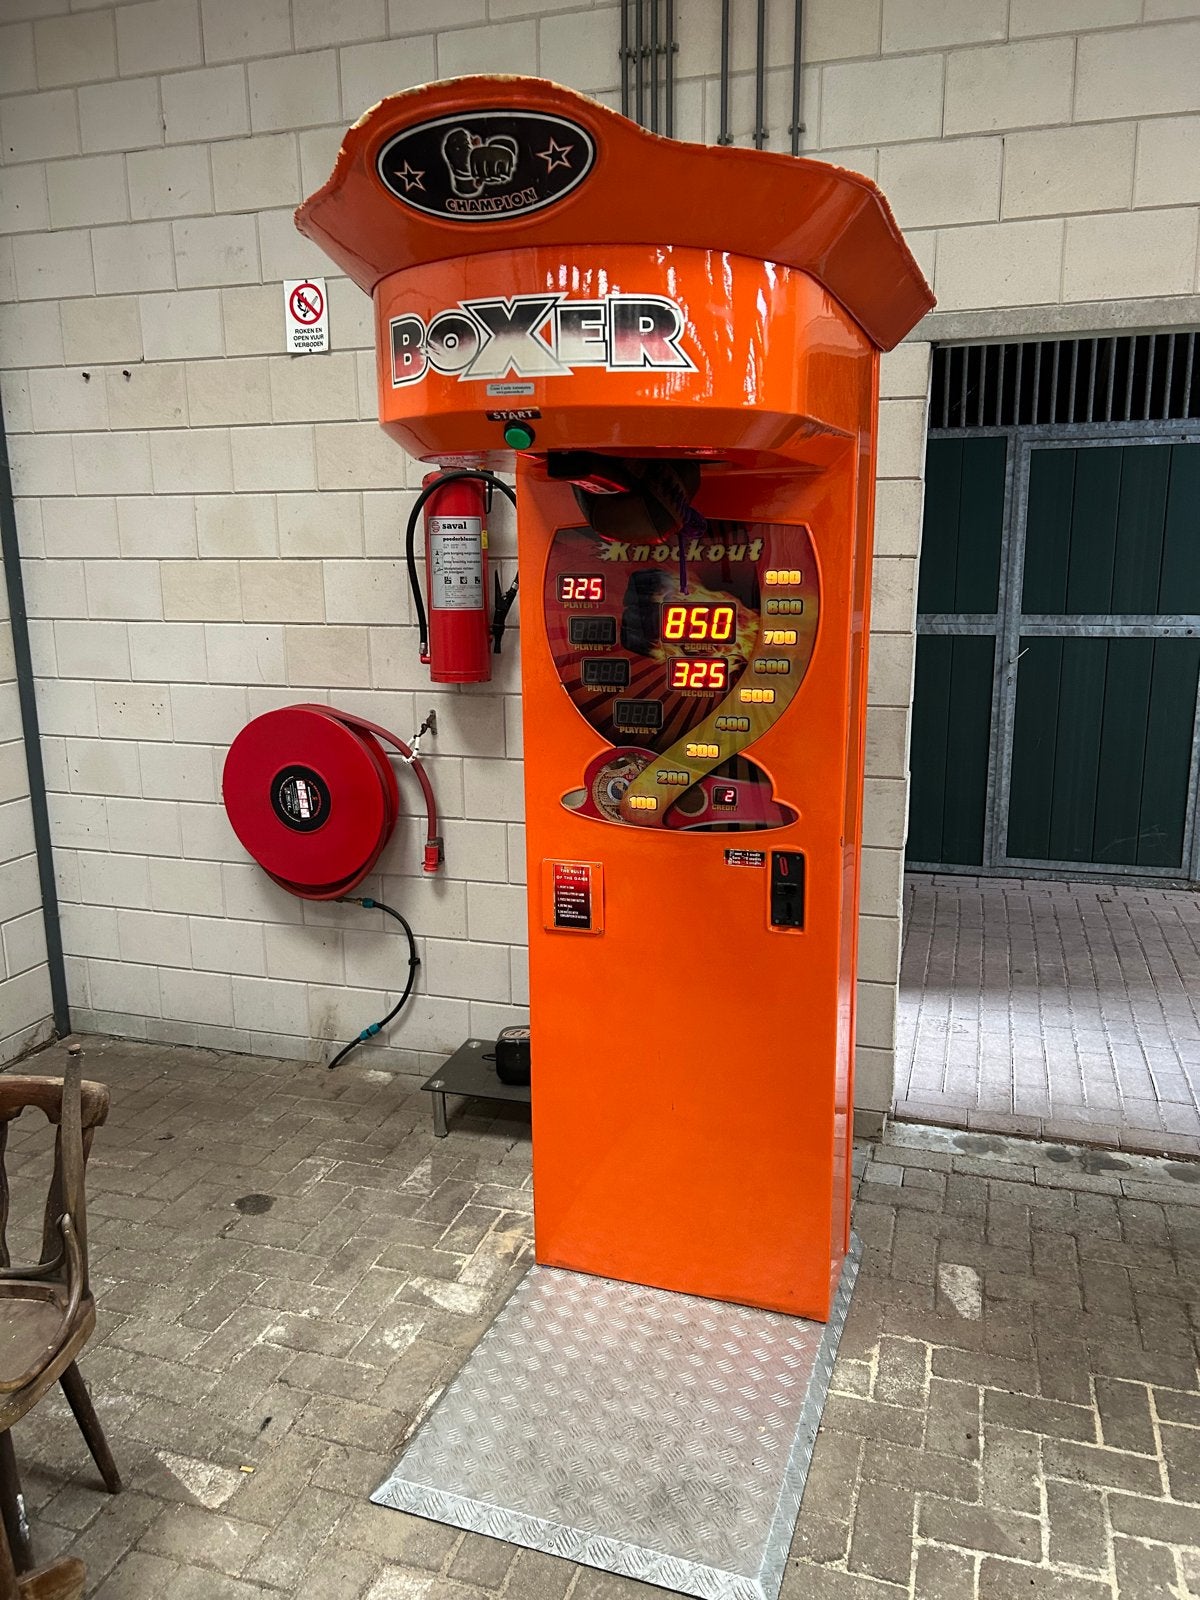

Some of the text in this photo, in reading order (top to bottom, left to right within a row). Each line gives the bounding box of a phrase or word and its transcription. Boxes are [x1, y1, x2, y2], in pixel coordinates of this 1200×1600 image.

[446, 187, 538, 213] CHAMPION
[389, 292, 699, 389] BOXER
[493, 410, 533, 421] START
[442, 521, 467, 530] saval
[602, 538, 764, 562] Knockout
[765, 570, 802, 585] 900
[561, 577, 602, 599] 325
[766, 599, 803, 615] 800
[665, 607, 734, 639] 850
[763, 630, 798, 645] 700
[574, 643, 603, 651] PLAYER
[754, 659, 790, 674] 600
[672, 662, 725, 688] 325
[681, 690, 715, 698] RECORD
[740, 688, 775, 703] 500
[619, 726, 658, 735] PLAYER 4
[715, 716, 750, 732] 400
[686, 743, 720, 758] 300
[656, 770, 689, 786] 200
[629, 796, 657, 811] 100
[724, 790, 735, 802] 2
